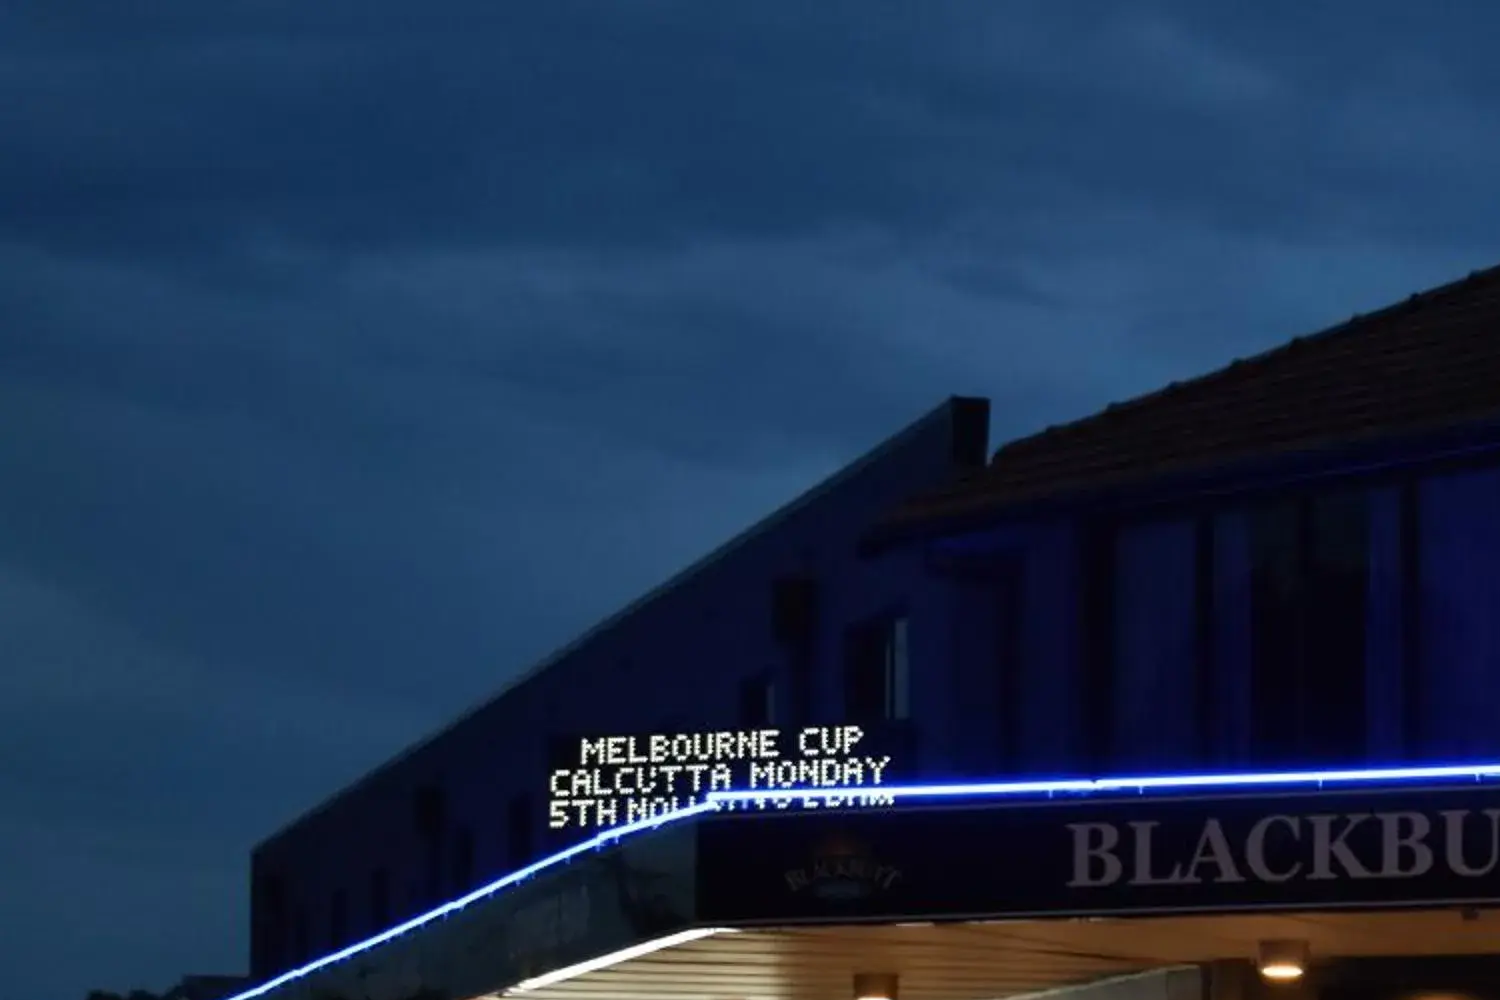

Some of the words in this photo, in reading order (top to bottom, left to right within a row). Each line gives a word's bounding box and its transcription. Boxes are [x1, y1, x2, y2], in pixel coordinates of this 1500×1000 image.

[580, 729, 781, 765] MELBOURNE
[800, 725, 865, 757] CUP
[549, 765, 732, 797] CALCUTTA
[750, 756, 890, 789] MONDAY
[549, 799, 618, 828] 5TH
